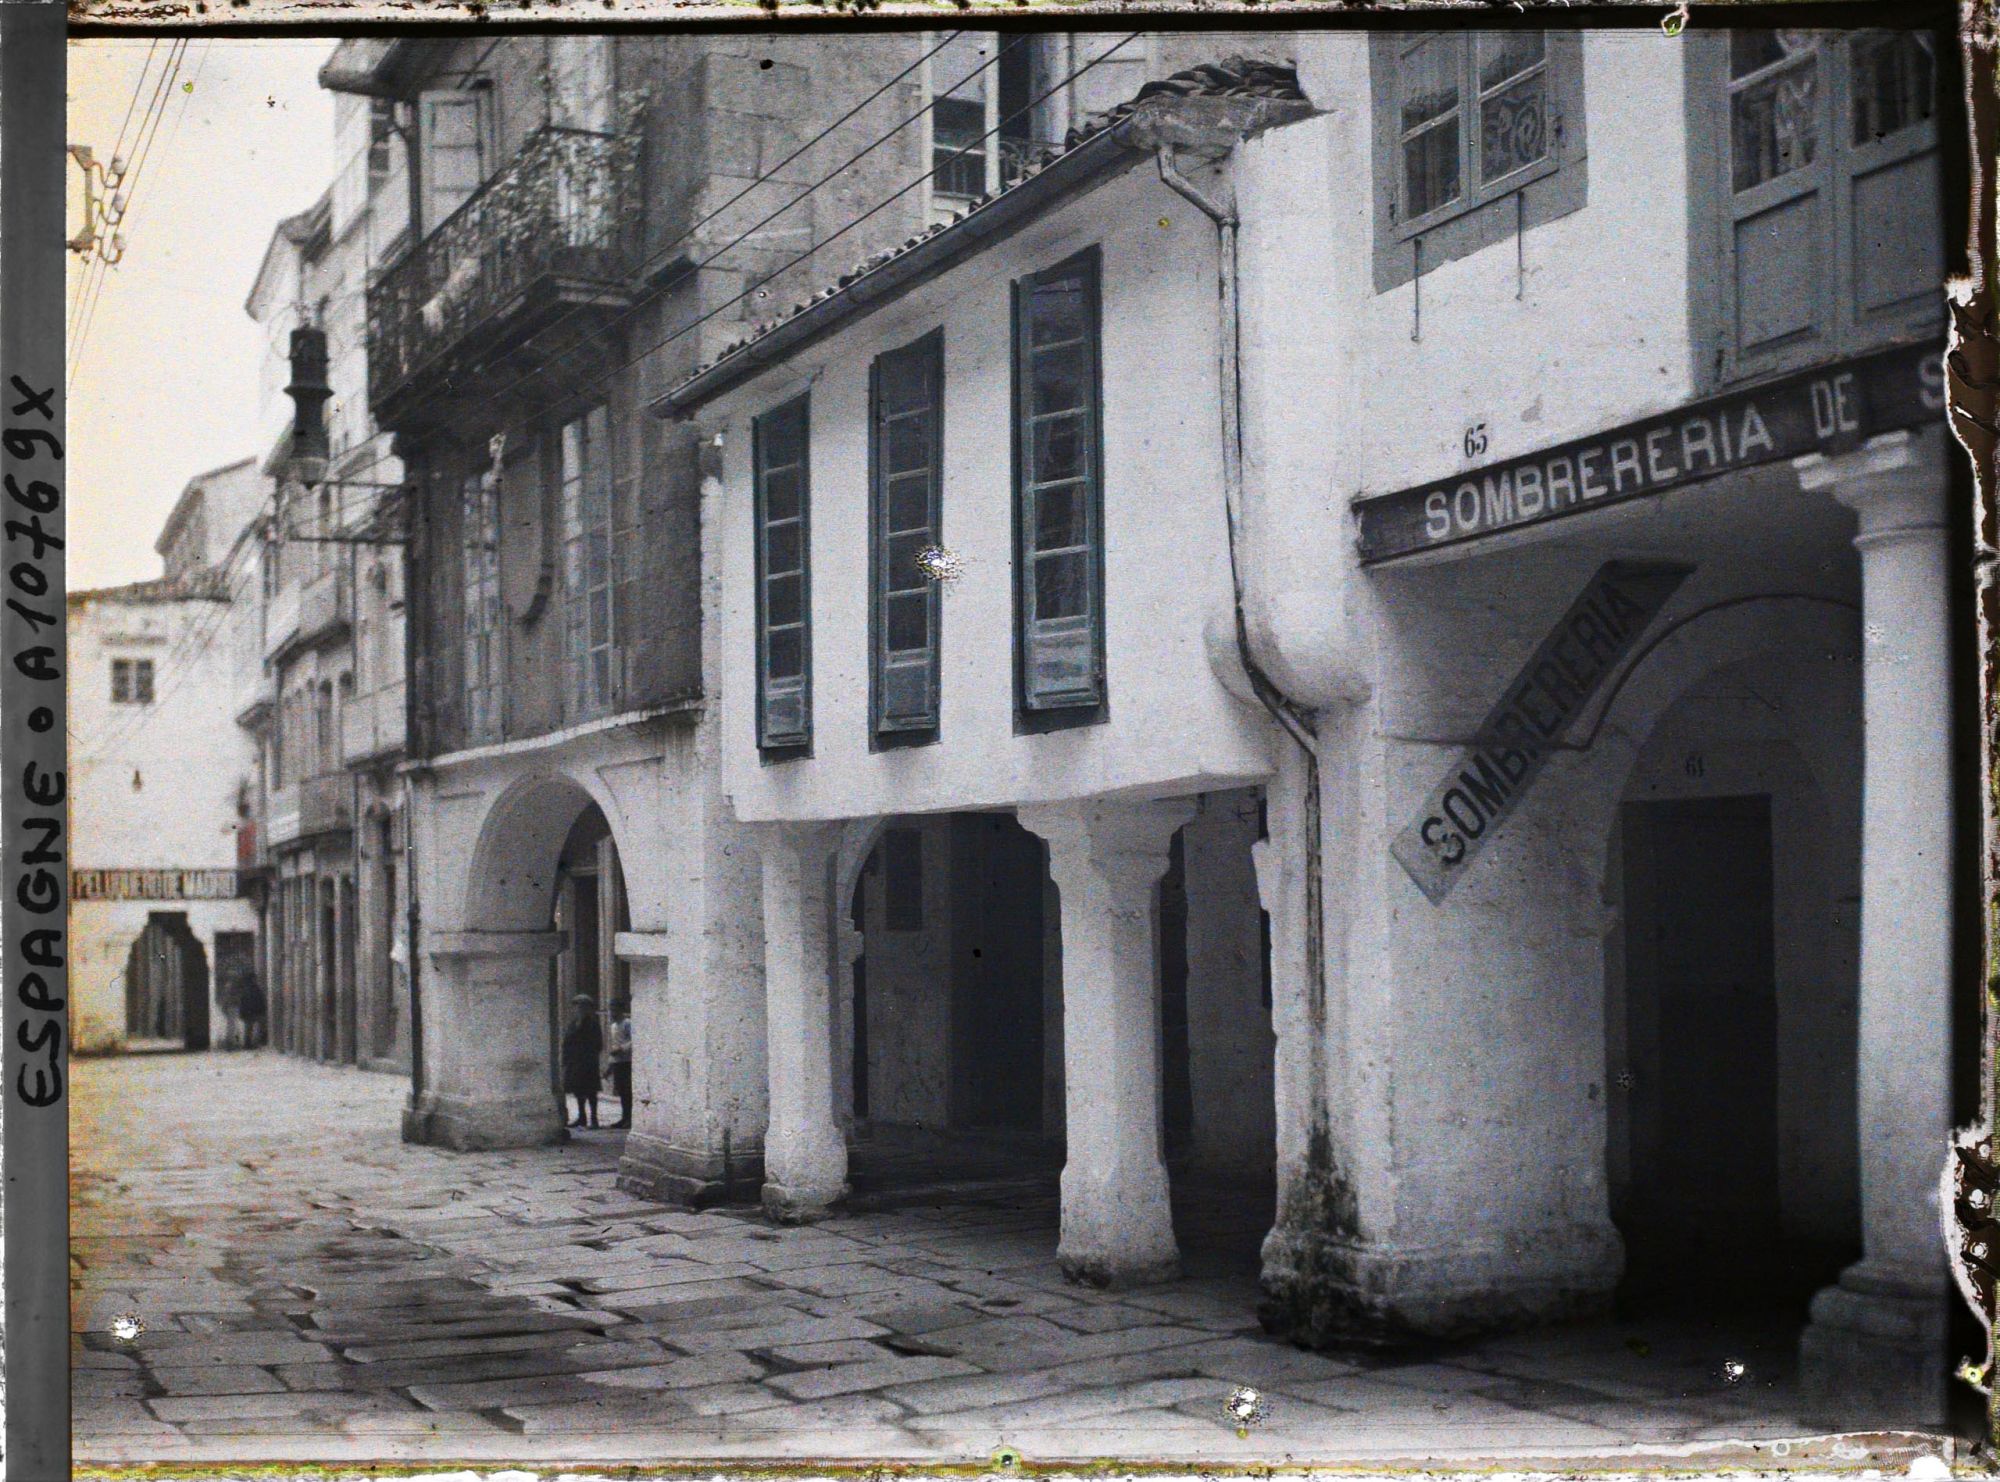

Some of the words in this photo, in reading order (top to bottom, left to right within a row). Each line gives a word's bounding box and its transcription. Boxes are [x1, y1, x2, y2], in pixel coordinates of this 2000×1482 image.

[1424, 402, 1775, 540] SOMBRERERIA
[1811, 372, 1859, 439] DE
[1464, 423, 1488, 458] 65
[1421, 581, 1645, 867] SOMBRERERIA
[18, 761, 65, 1108] ESPAGNE
